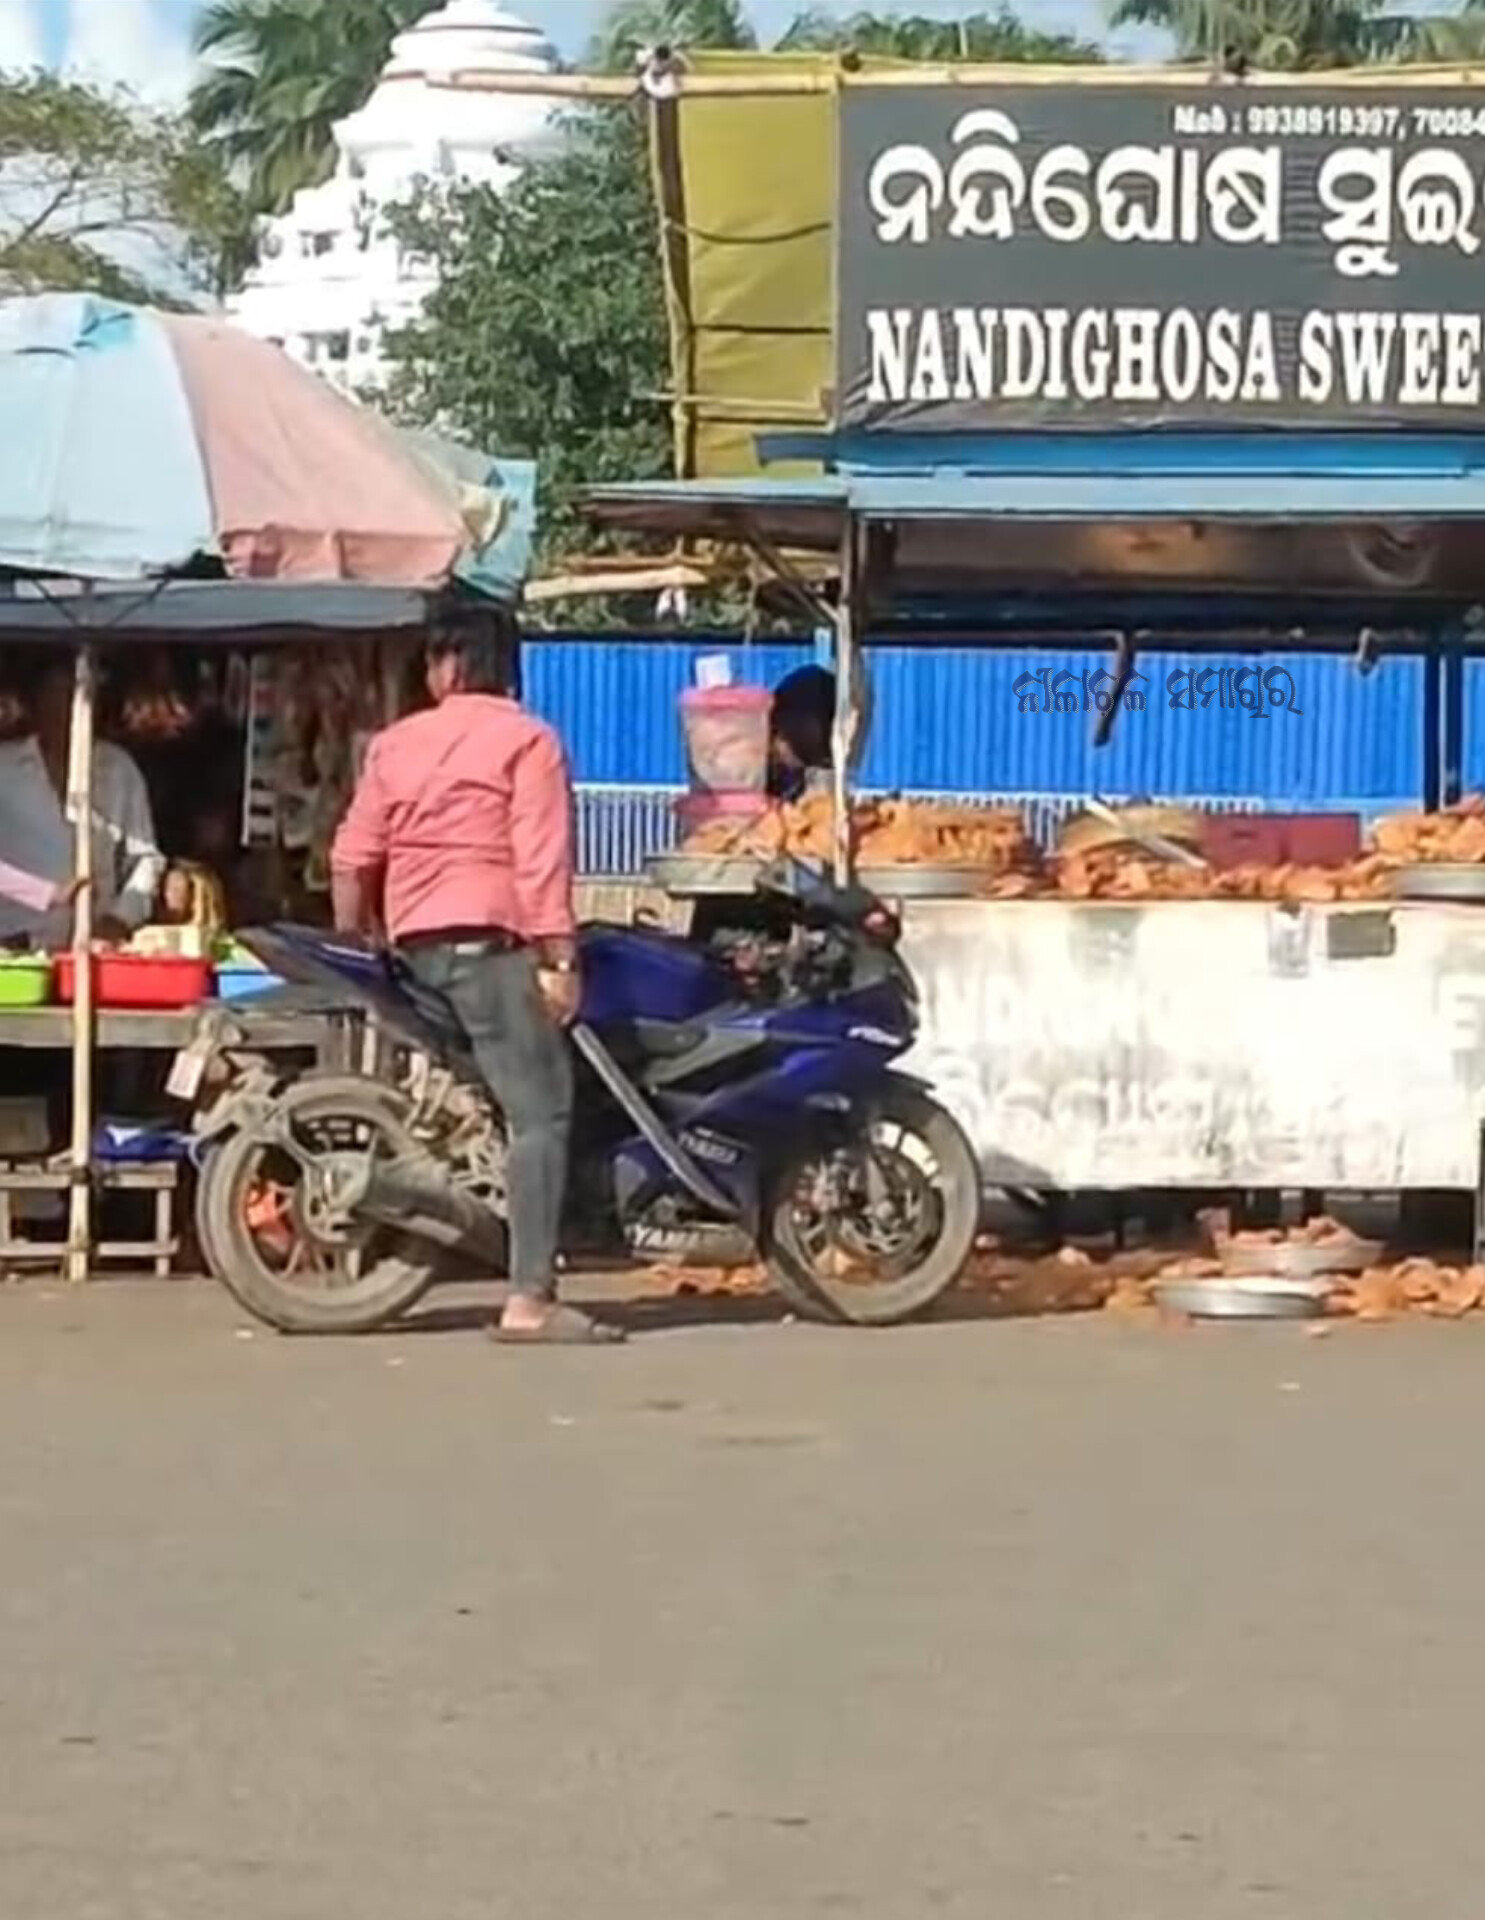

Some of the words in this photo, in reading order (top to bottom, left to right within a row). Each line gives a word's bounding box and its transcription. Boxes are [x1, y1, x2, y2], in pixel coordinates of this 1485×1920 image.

[869, 109, 1282, 243] ନନ୍ଦିଘୋଷ
[1317, 146, 1485, 277] ସୁଇ
[866, 307, 1281, 402] NANDIGHOSA
[1299, 309, 1482, 405] SWEE
